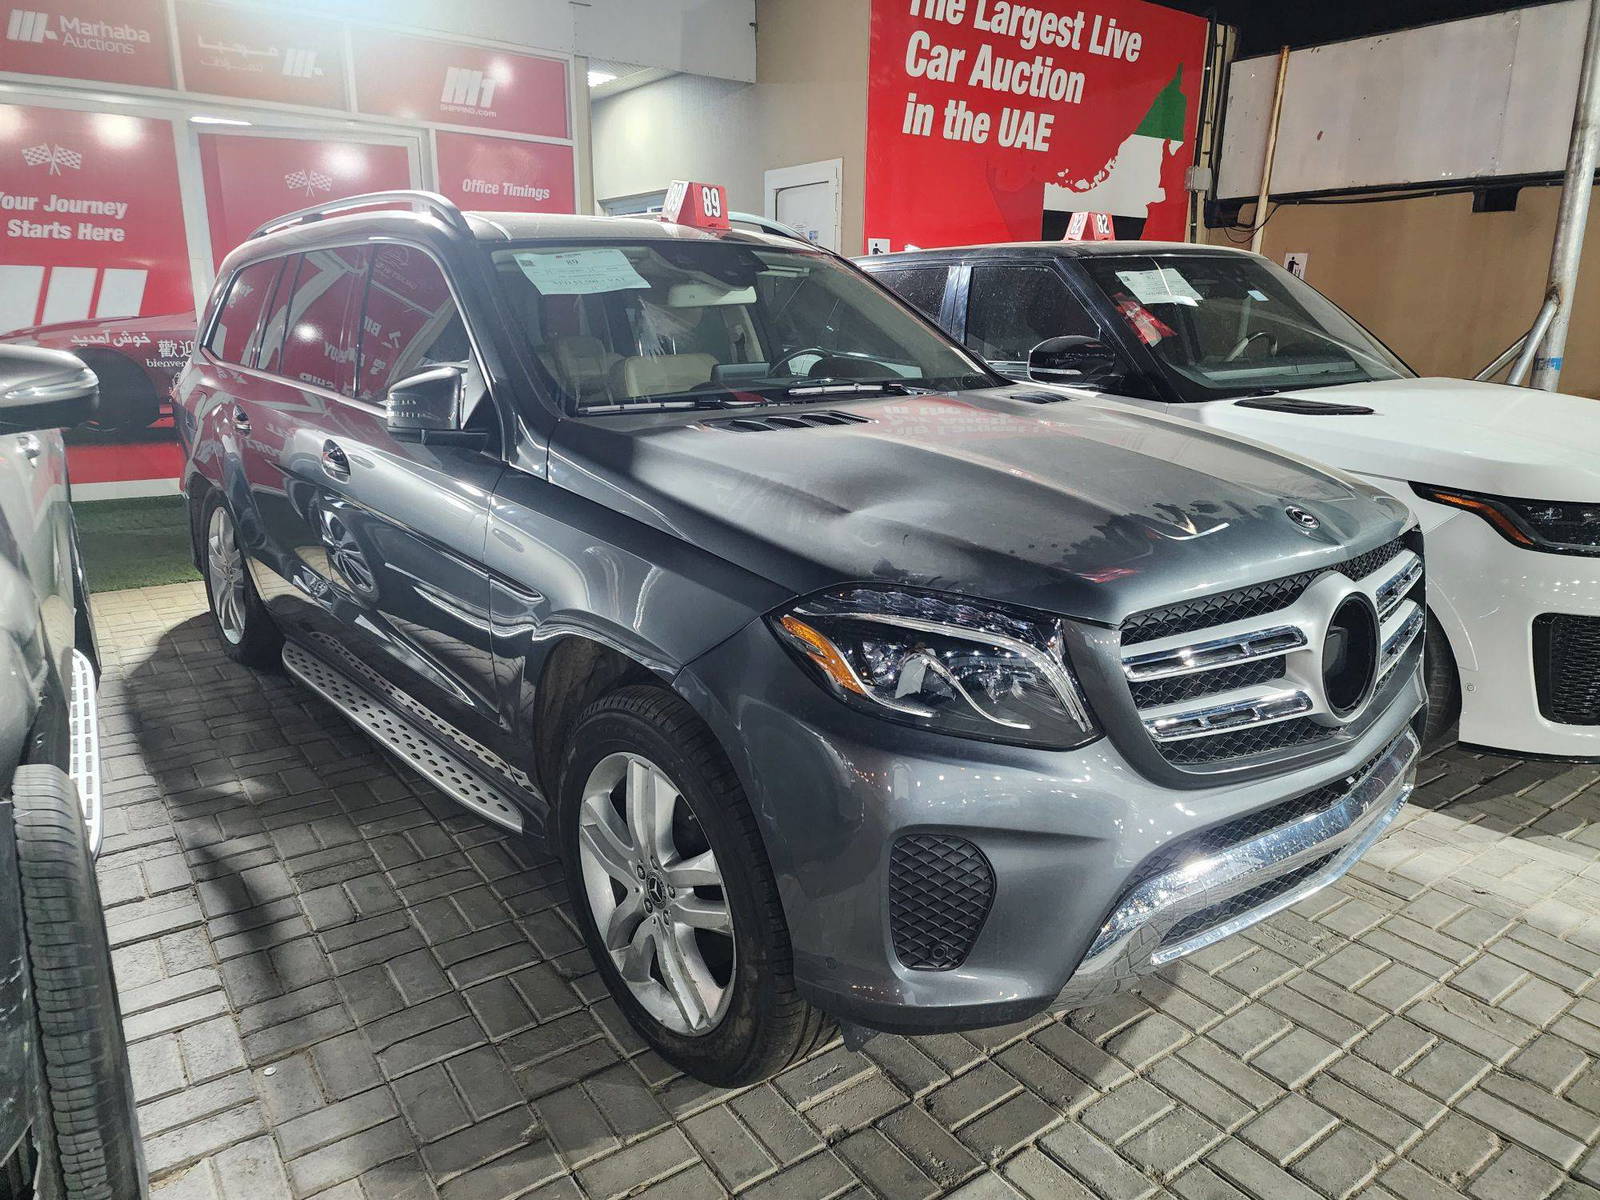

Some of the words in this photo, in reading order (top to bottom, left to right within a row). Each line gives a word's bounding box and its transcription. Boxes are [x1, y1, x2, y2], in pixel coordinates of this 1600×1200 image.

[59, 14, 151, 43] Marhaba
[973, 0, 1085, 51] Largest
[1088, 14, 1142, 63] Live
[62, 31, 136, 54] Auctions
[905, 30, 966, 83] Car
[968, 43, 1086, 104] Auction
[902, 92, 935, 137] in
[943, 99, 991, 144] the
[998, 107, 1055, 152] UAE
[462, 178, 500, 195] Office
[502, 182, 550, 201] Timings
[702, 186, 721, 218] 89
[43, 194, 128, 220] Journey
[7, 218, 72, 240] Starts
[77, 222, 126, 242] Here
[1096, 214, 1110, 234] 82
[113, 331, 151, 348] خوش
[145, 358, 189, 368] bienven
